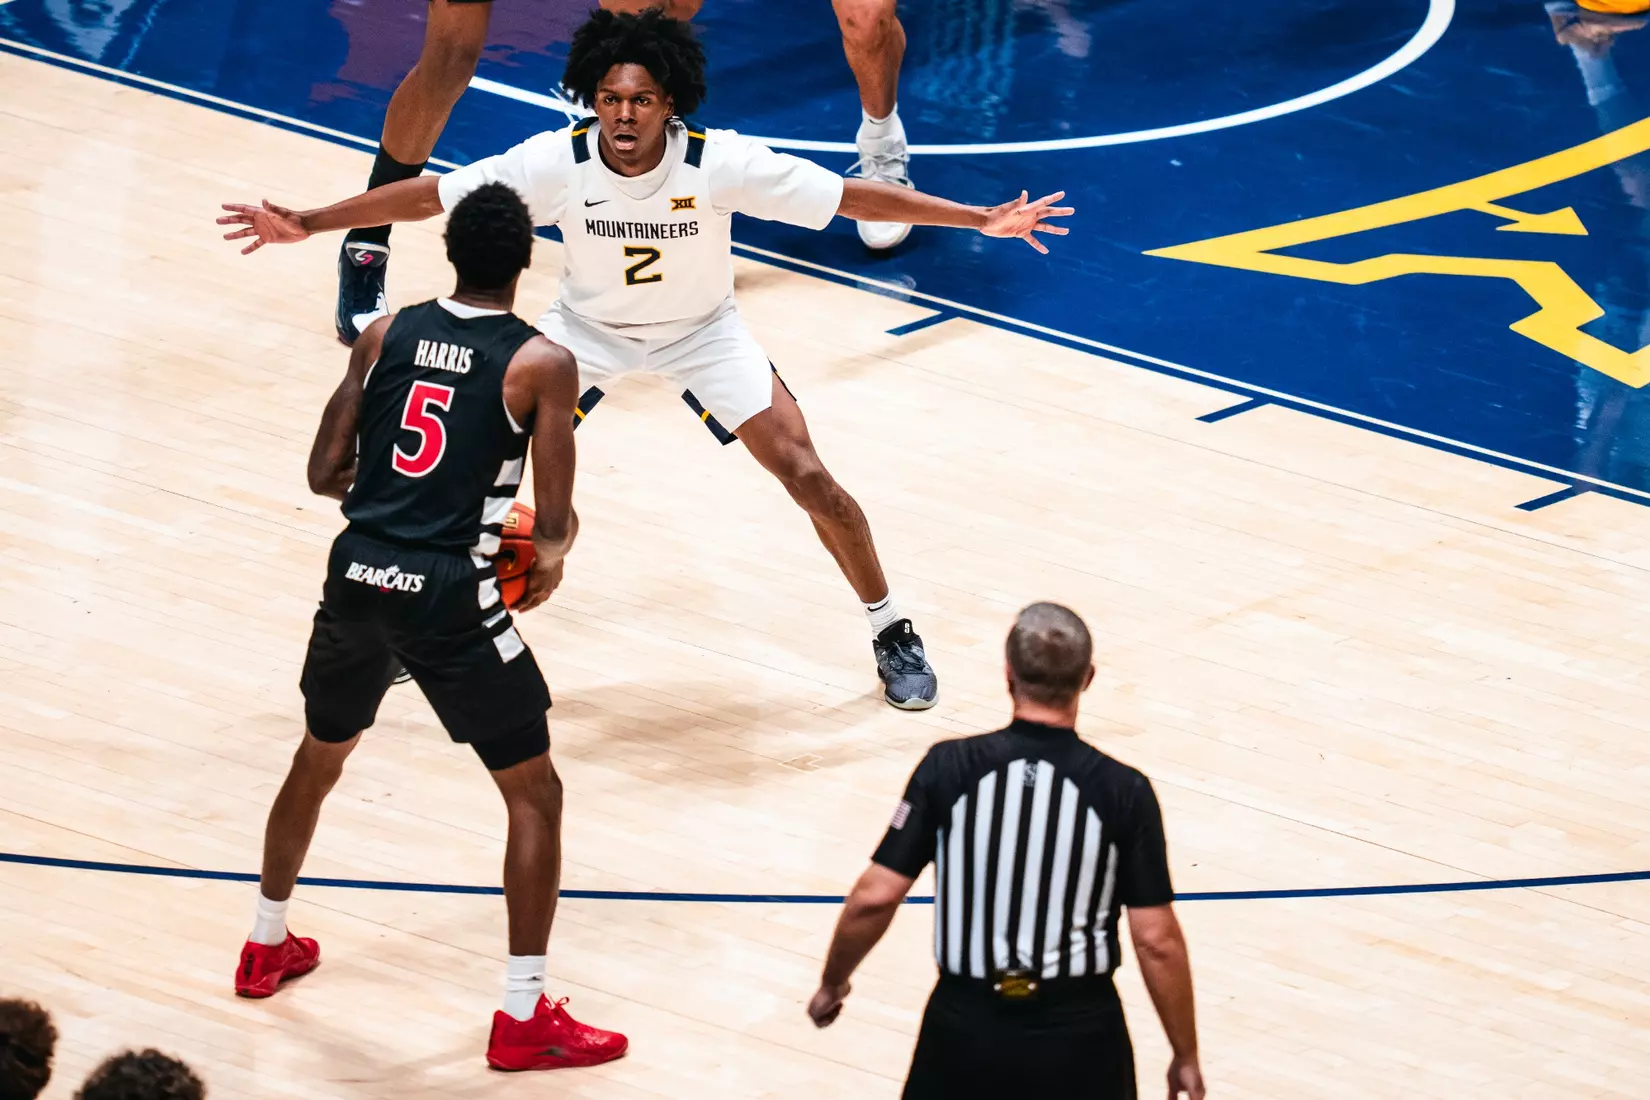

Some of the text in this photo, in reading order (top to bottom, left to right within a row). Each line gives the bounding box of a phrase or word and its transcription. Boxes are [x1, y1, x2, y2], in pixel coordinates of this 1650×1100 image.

[670, 196, 696, 212] XII
[585, 218, 699, 239] MOUNTAINEERS
[623, 245, 663, 286] 2
[414, 340, 473, 374] HARRIS
[391, 380, 455, 478] 5
[344, 562, 425, 593] BEARCATS
